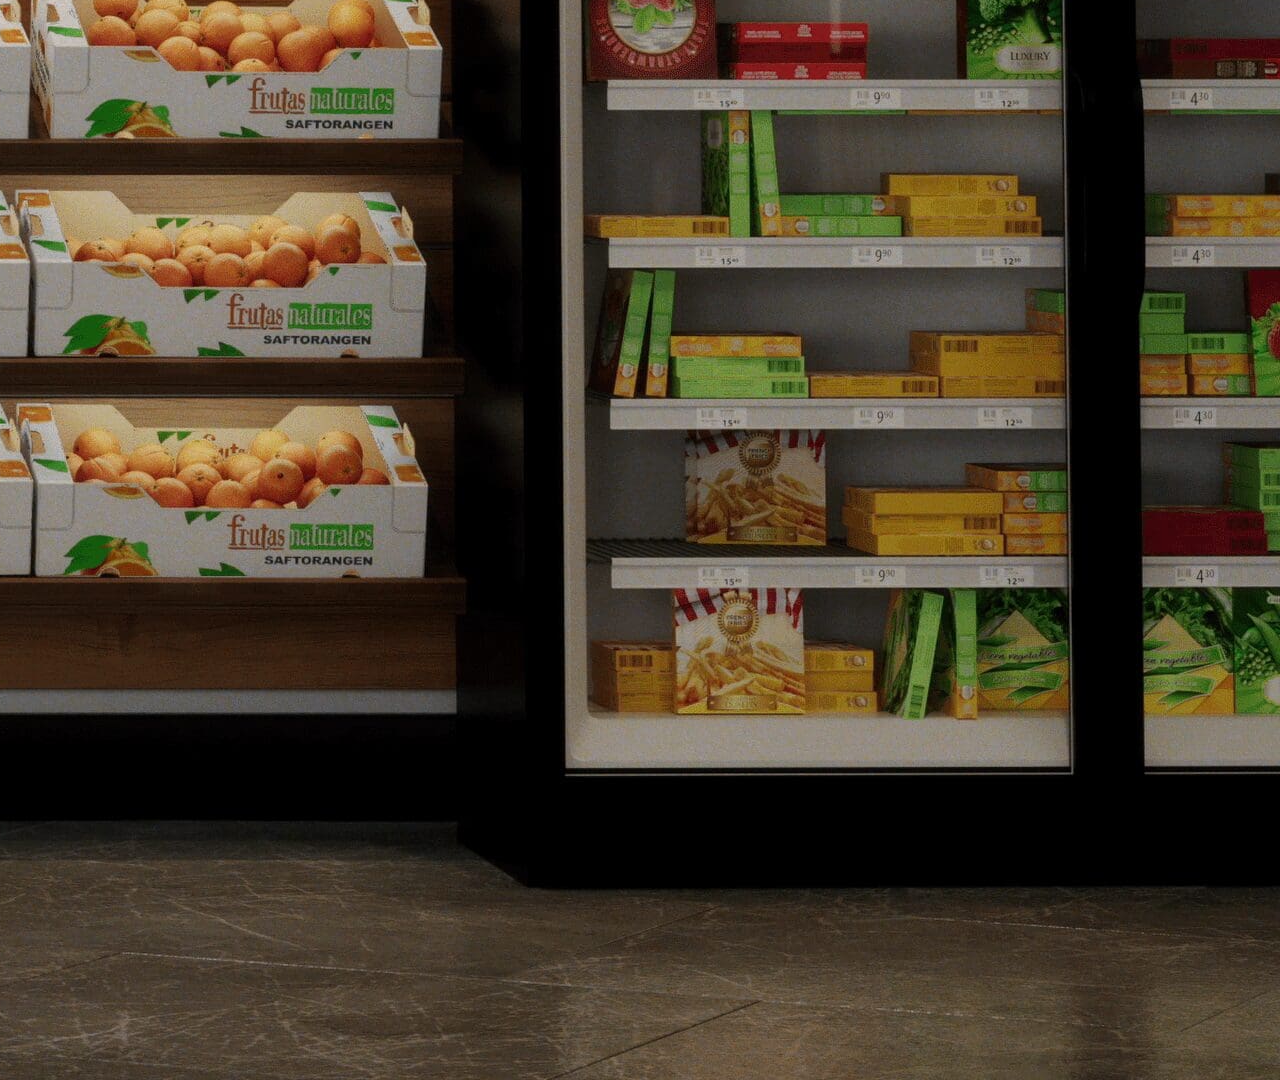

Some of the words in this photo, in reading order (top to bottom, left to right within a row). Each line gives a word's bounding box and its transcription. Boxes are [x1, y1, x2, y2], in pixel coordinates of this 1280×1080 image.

[1010, 51, 1050, 61] LUXURY
[248, 78, 306, 114] frutas
[310, 88, 395, 114] naturales
[285, 120, 394, 130] SAFTORANGEN
[226, 294, 284, 330] frutas
[288, 304, 373, 330] naturales
[263, 335, 372, 345] SAFTORANGEN
[227, 515, 285, 550] frutas
[289, 524, 374, 550] naturales
[264, 555, 373, 565] SAFTORANGEN
[1008, 648, 1057, 663] vegetables
[1160, 655, 1208, 667] vegetables
